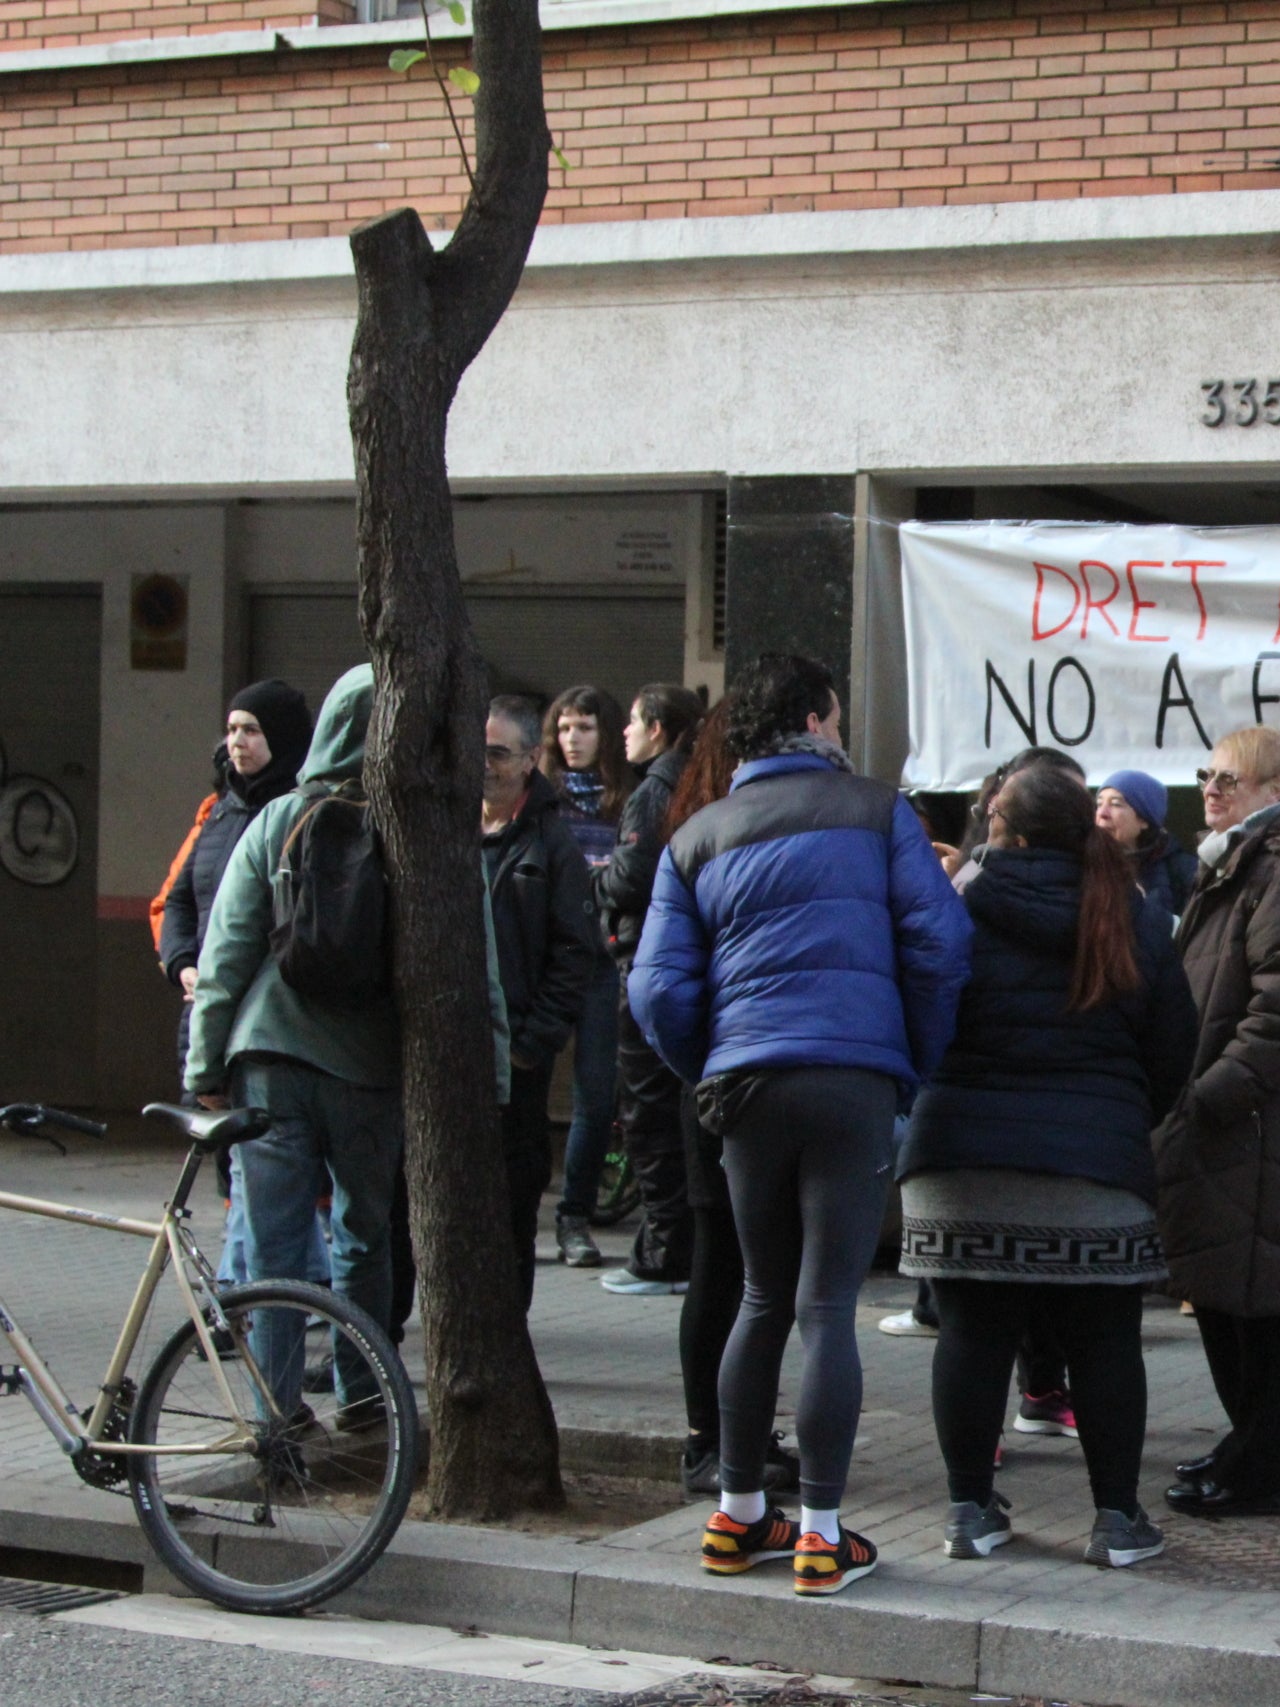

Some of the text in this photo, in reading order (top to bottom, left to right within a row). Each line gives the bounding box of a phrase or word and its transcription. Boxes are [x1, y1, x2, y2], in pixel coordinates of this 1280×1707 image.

[1031, 560, 1227, 642] DRET
[984, 655, 1097, 750] NO
[1154, 652, 1214, 751] A
